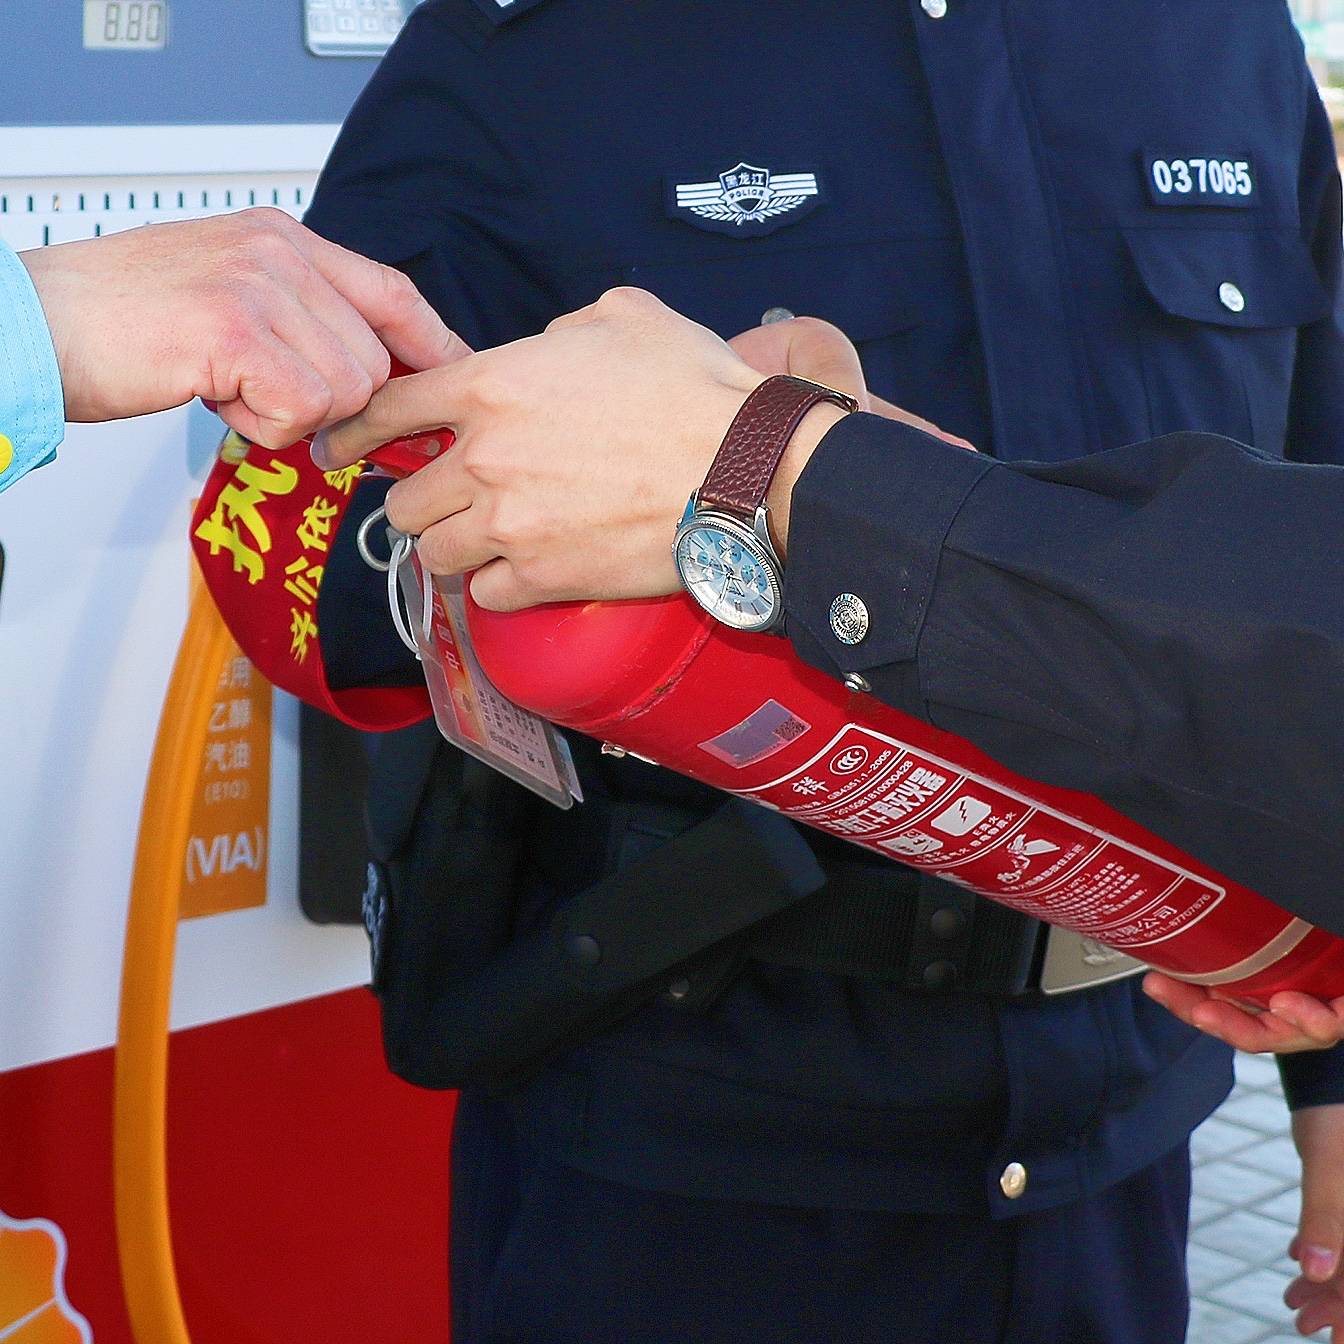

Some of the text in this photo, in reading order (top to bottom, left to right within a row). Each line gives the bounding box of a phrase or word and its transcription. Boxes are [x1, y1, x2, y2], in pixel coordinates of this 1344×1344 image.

[725, 172, 765, 188] 黑龙江
[1153, 159, 1252, 195] 037065
